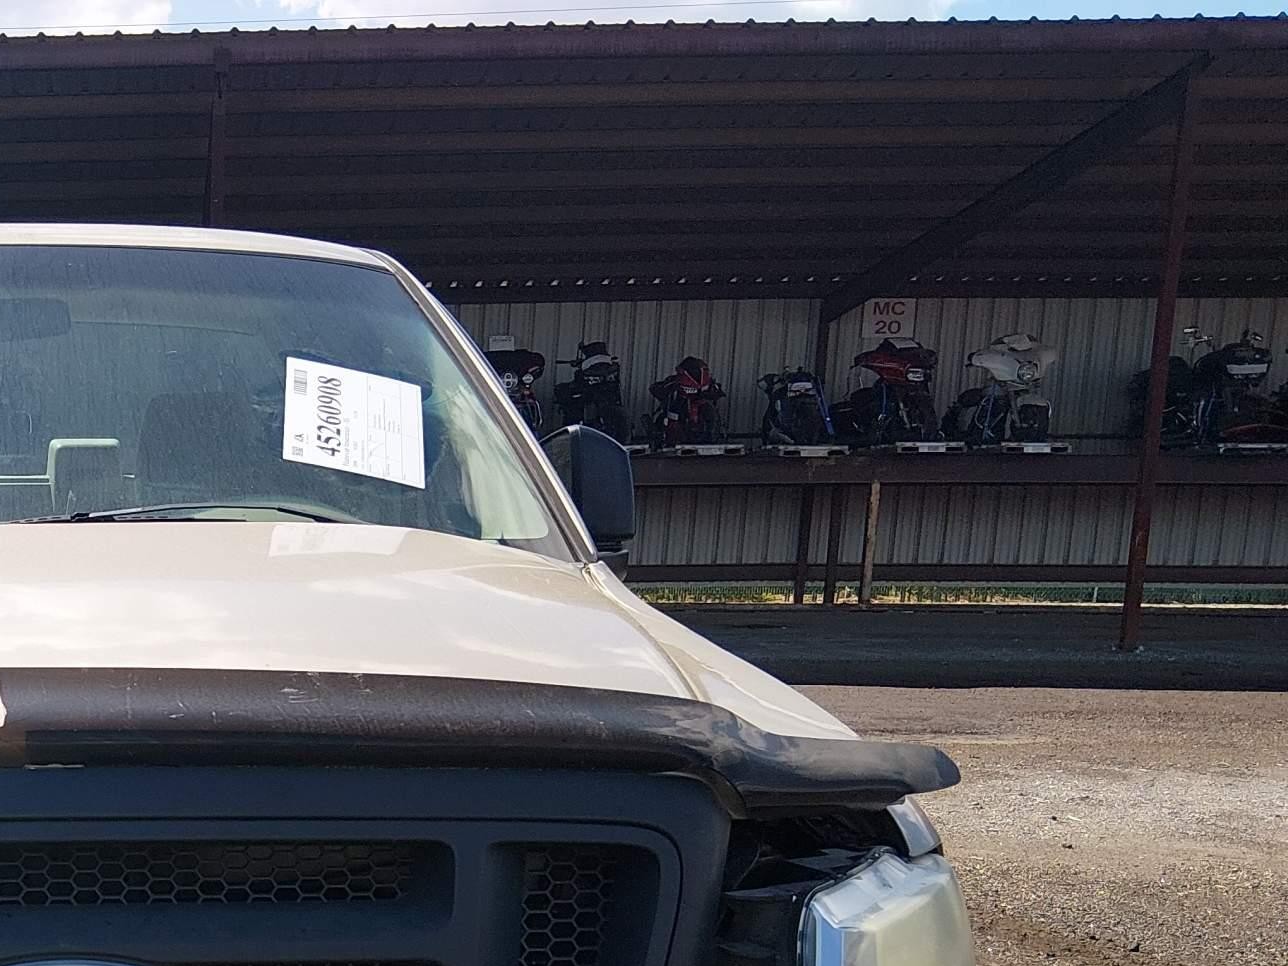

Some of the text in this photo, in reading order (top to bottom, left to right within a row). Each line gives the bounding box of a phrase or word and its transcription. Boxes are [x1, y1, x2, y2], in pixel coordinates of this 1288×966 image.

[873, 301, 906, 316] MC
[874, 320, 902, 335] 20
[316, 375, 343, 457] 45260908
